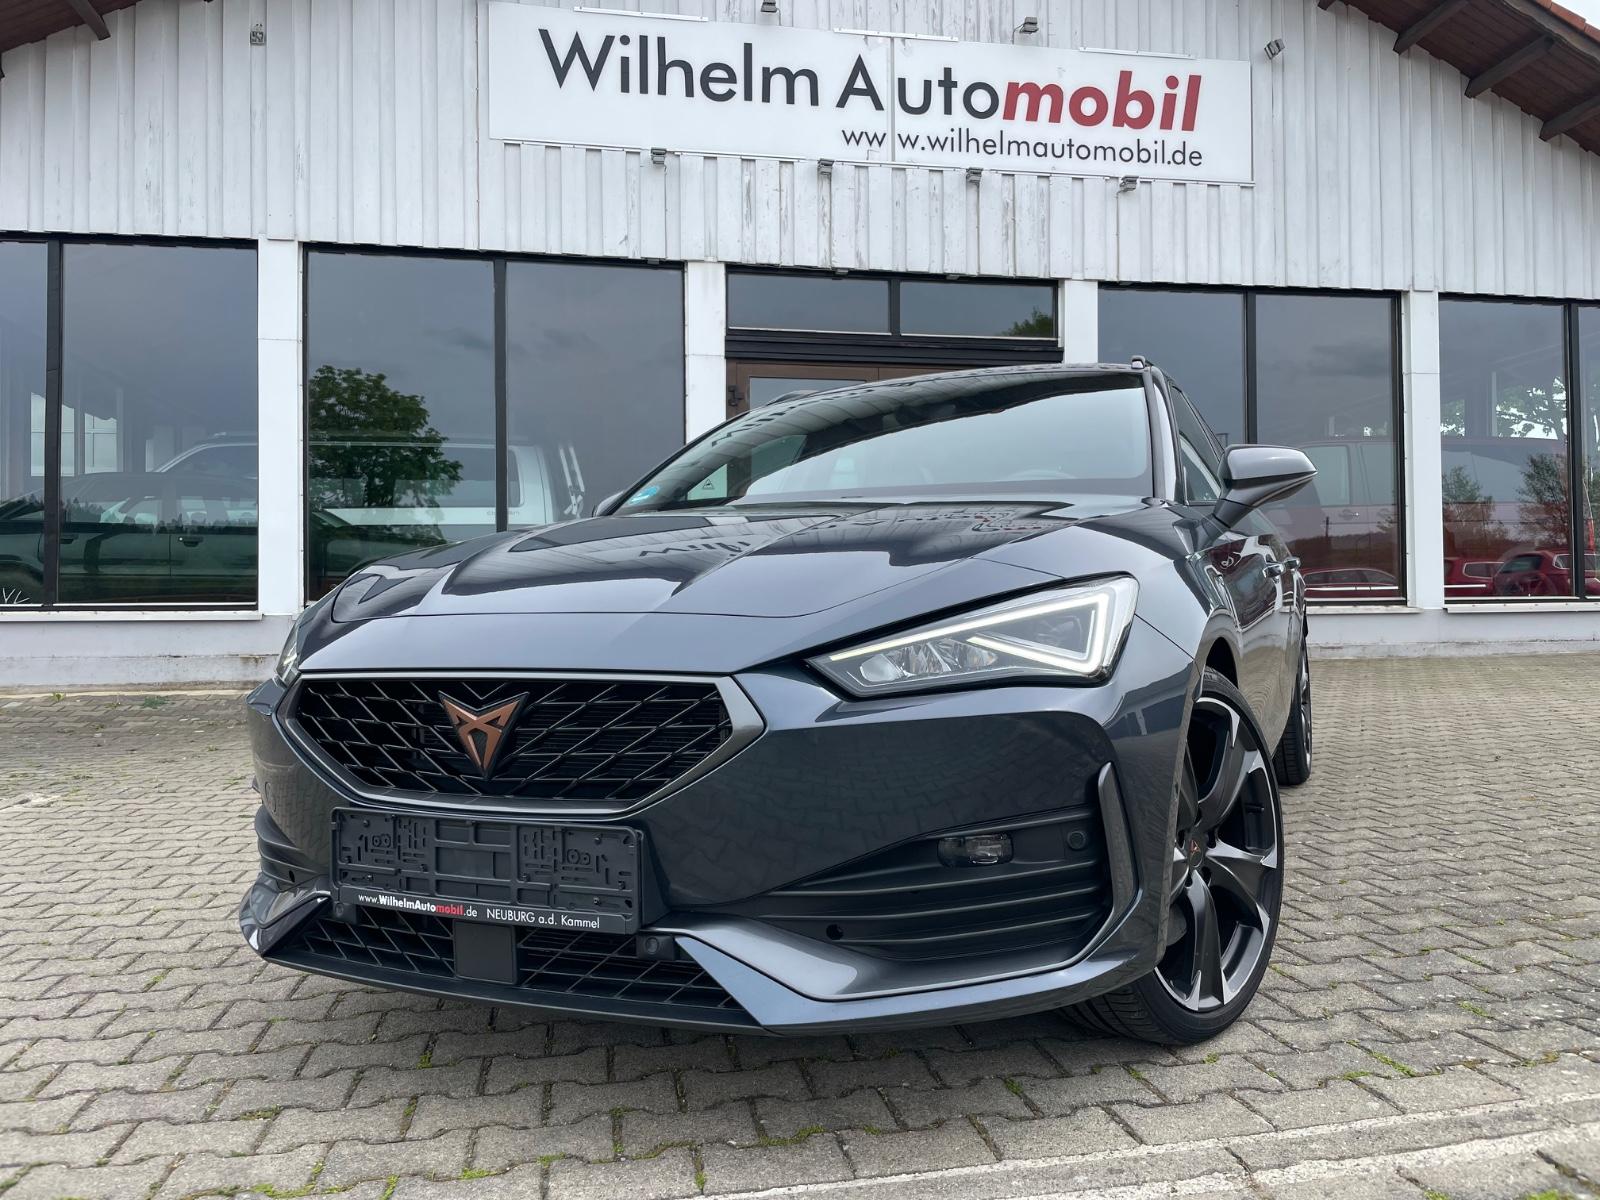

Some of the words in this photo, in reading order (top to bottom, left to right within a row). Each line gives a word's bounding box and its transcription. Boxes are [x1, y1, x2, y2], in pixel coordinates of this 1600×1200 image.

[538, 28, 819, 107] Wilhelm
[835, 53, 1202, 132] Automobil
[841, 127, 1203, 167] www.wilhelmautomobil.de
[486, 908, 536, 923] NEUBURG
[538, 913, 558, 926] a.d.
[561, 914, 600, 929] Kammel
